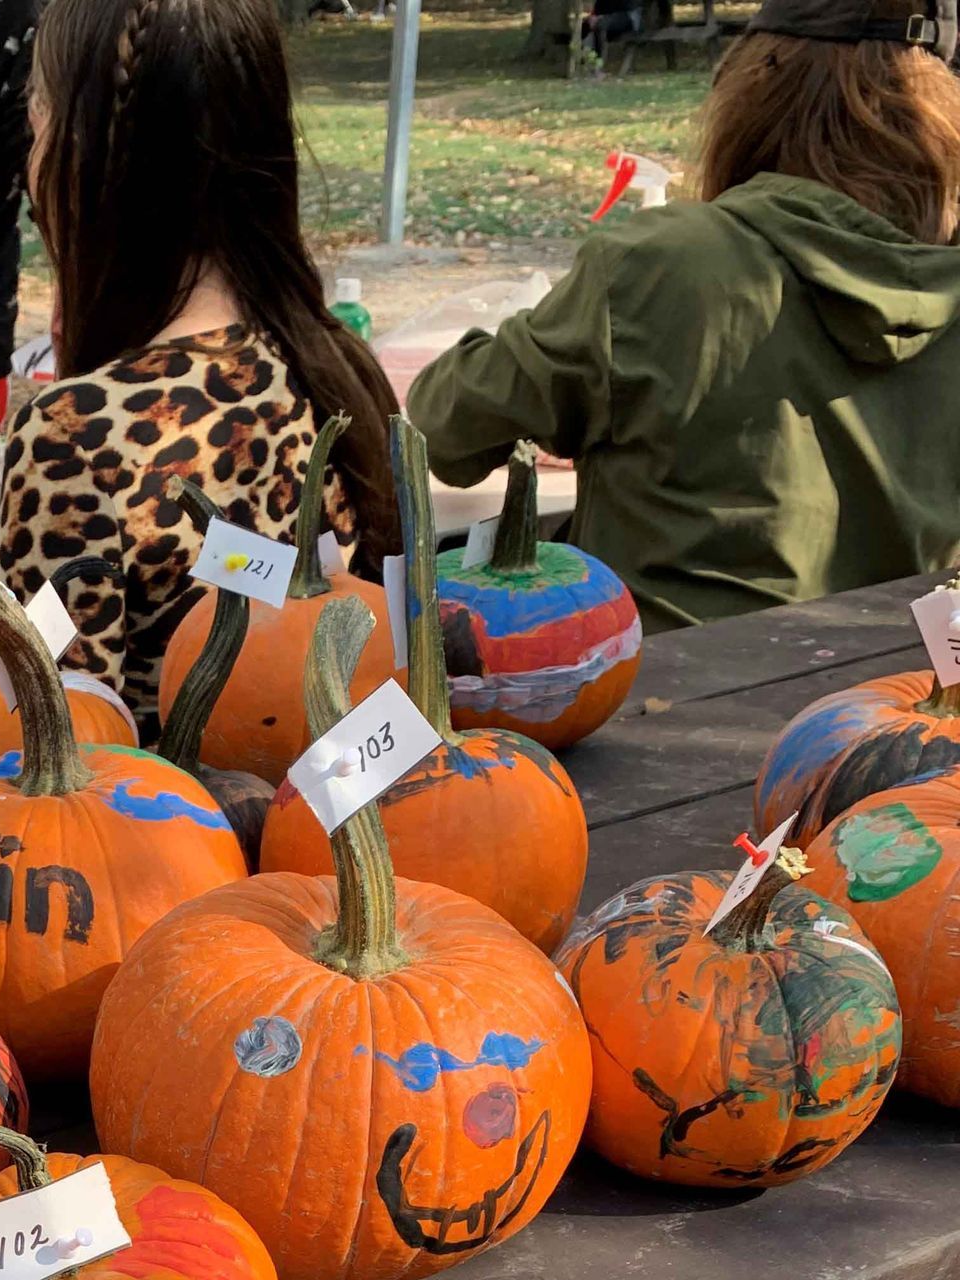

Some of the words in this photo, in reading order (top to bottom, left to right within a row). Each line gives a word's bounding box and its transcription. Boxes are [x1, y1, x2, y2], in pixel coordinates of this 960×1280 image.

[243, 559, 273, 580] 121
[358, 722, 395, 772] 103
[0, 1224, 49, 1269] 102
